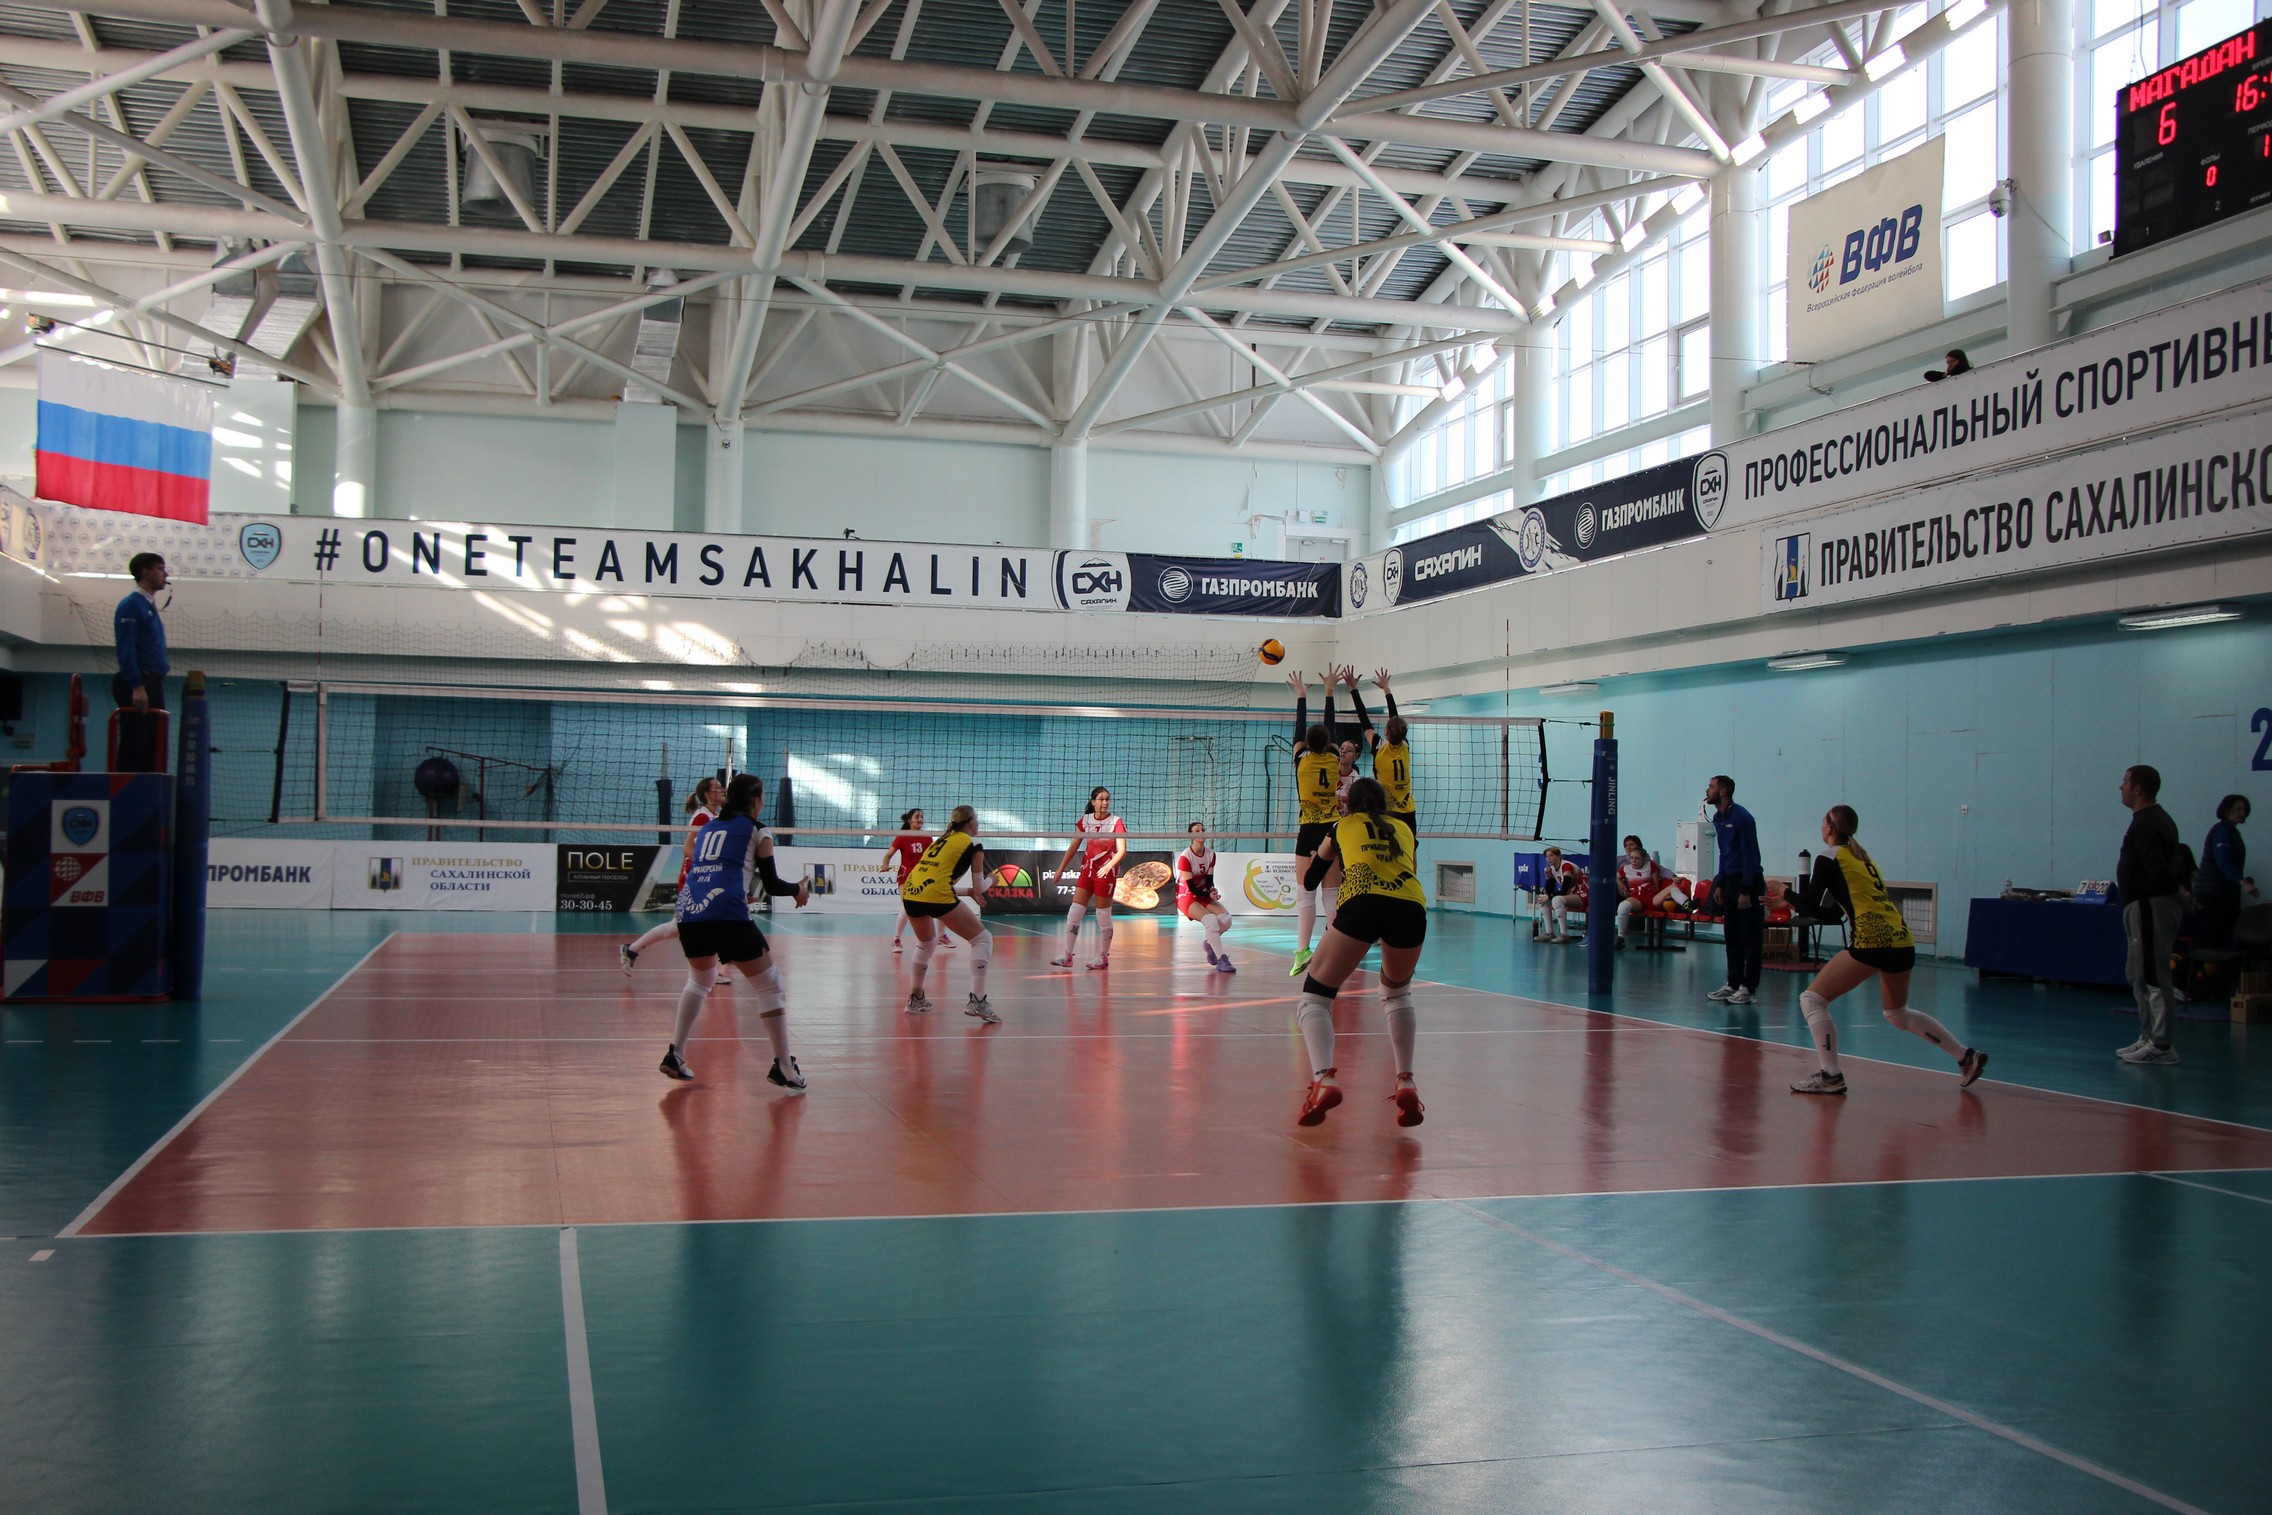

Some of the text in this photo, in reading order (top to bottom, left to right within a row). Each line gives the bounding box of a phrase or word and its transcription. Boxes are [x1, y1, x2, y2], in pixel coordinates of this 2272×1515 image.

[2129, 30, 2256, 112] МАГАДАН
[2158, 101, 2177, 146] 6
[2263, 133, 2271, 158] 1
[2205, 165, 2218, 188] 0
[2214, 200, 2221, 211] 2
[1839, 203, 1923, 285] ВФВ
[1806, 262, 1923, 313] Всероссийская федерация волейбола
[1745, 368, 2042, 500] ПРОФЕССИОНАЛЬНЫЙ
[1601, 487, 1686, 532] ГАЗПРОМБАНК
[1820, 497, 2034, 587] ПРАВИТЕЛЬСТВО
[314, 527, 1028, 598] #ONETEAMSAKHALIN
[1414, 543, 1482, 581] САХАЛИН
[1201, 577, 1319, 599] ГАЗПРОМБАНК
[2250, 707, 2272, 771] 2
[1319, 768, 1329, 789] 4
[1392, 759, 1404, 781] 11
[1608, 776, 1616, 816] JINLING
[698, 829, 728, 862] 10
[911, 842, 923, 854] 13
[411, 856, 523, 867] ПРАВИТЕЛЬСТВО
[1199, 863, 1205, 874] 5
[430, 868, 532, 880] САХАЛИНСКОЙ
[1864, 862, 1883, 891] 9
[70, 890, 105, 904] ВФВ
[430, 882, 491, 892] ОБЛАСТИ
[988, 888, 1034, 898] СКАЗКА
[1108, 883, 1114, 895] 7
[560, 899, 613, 911] 30-30-45
